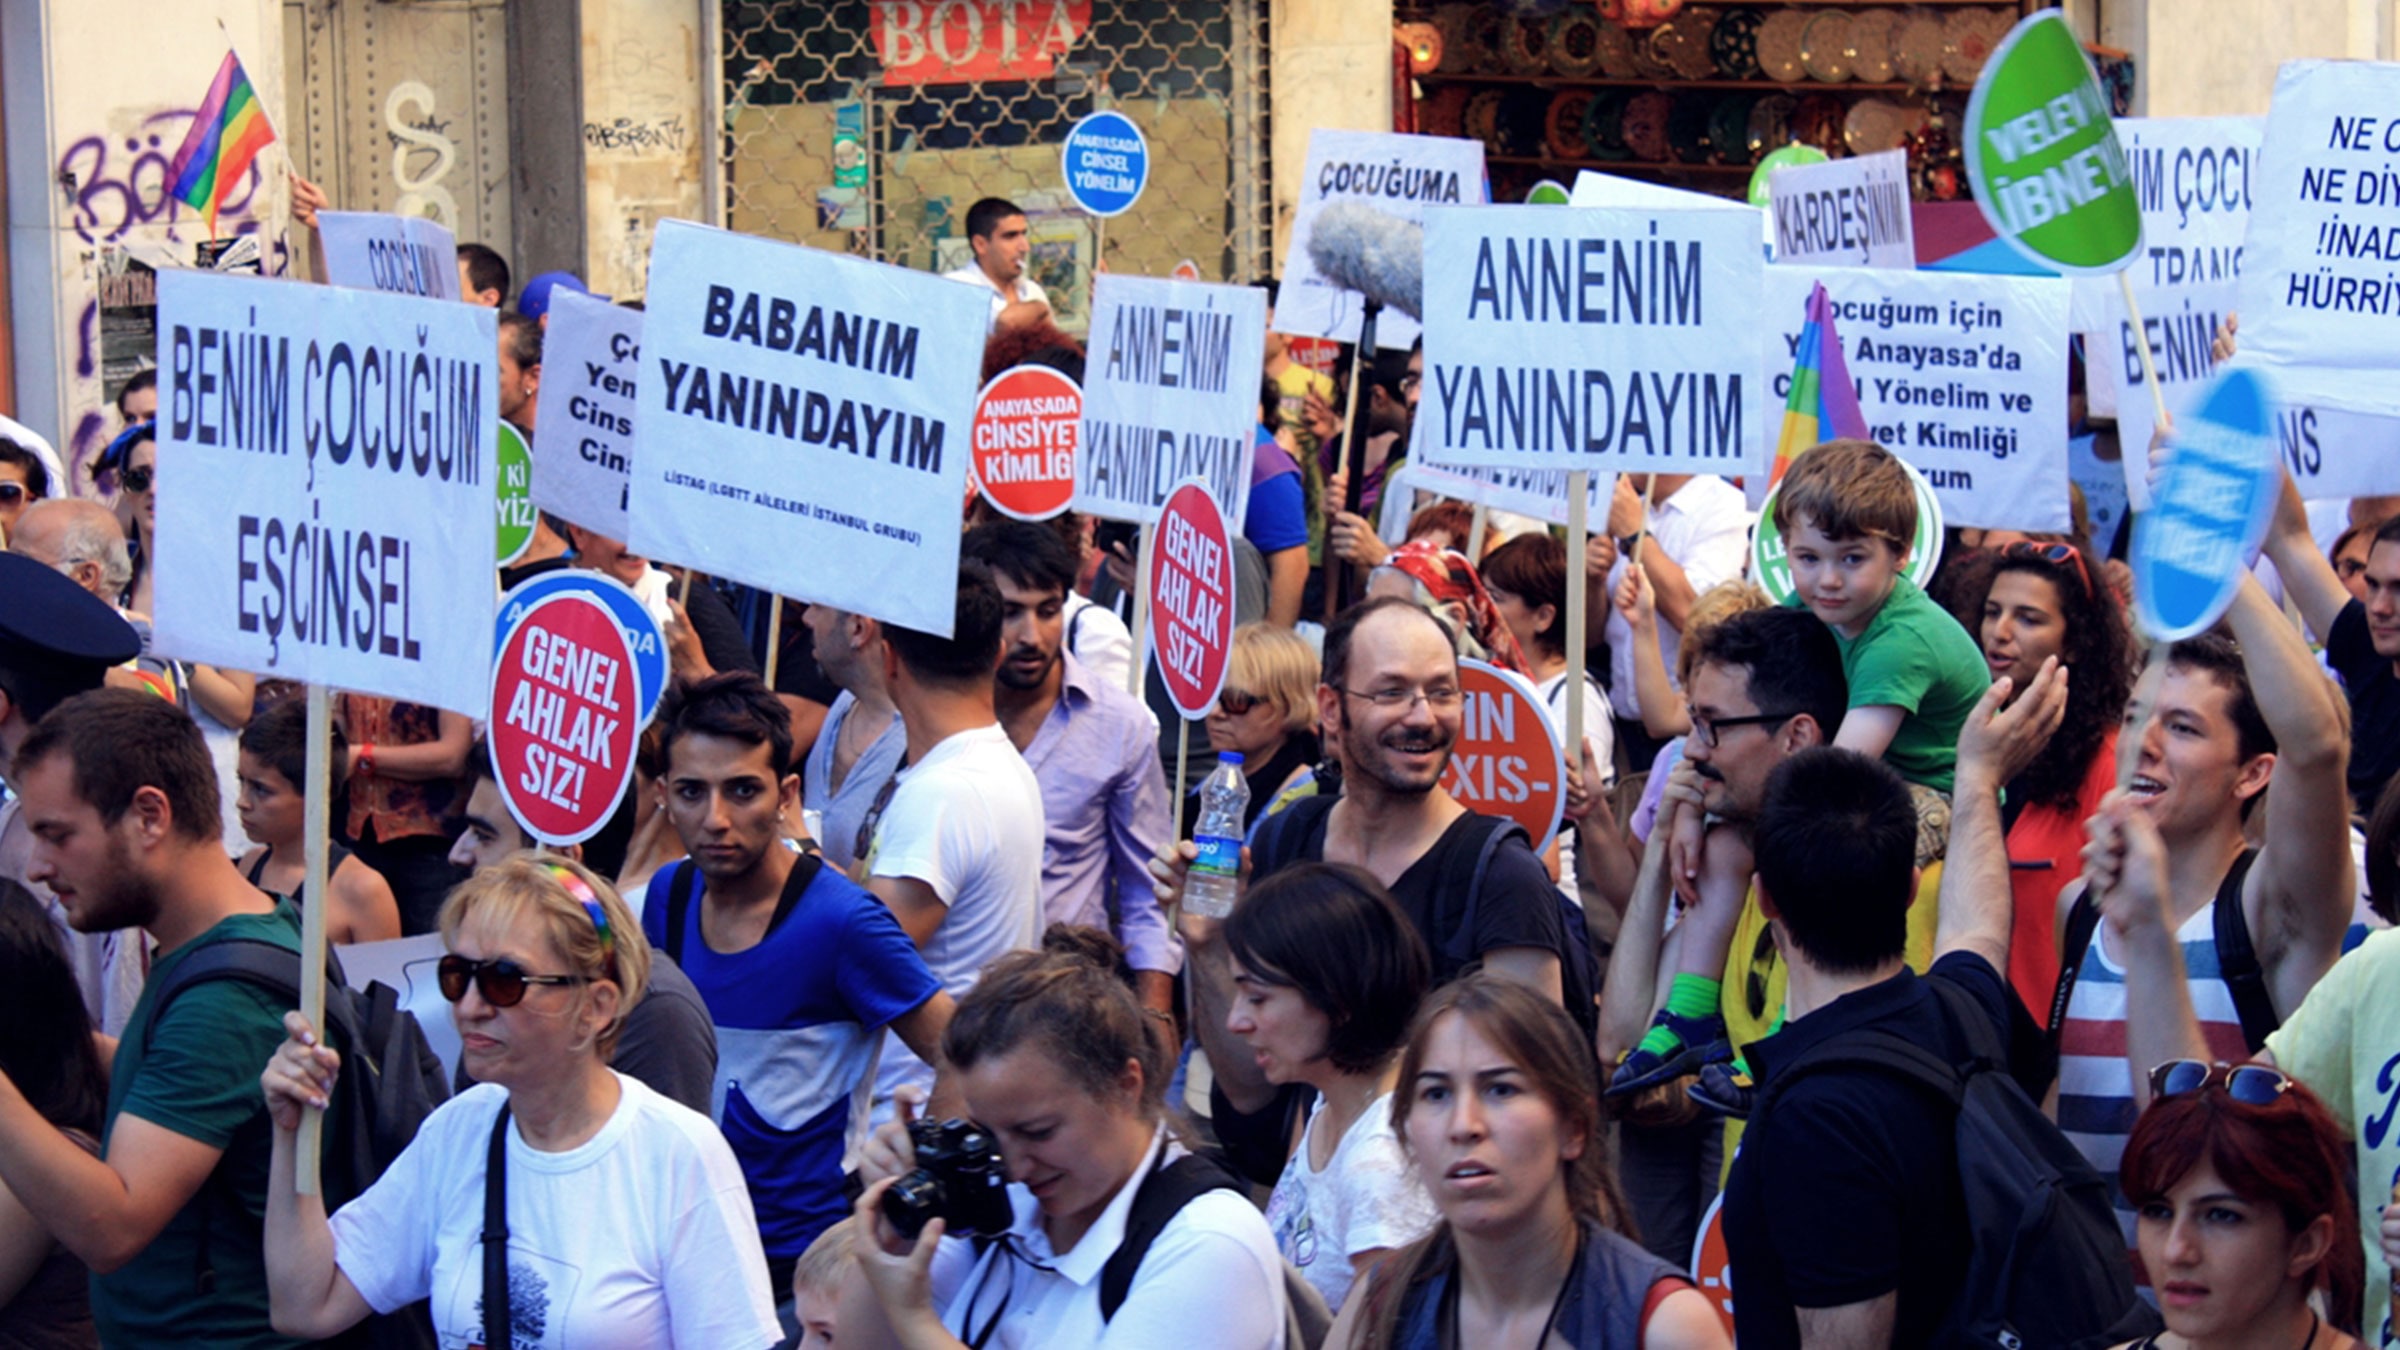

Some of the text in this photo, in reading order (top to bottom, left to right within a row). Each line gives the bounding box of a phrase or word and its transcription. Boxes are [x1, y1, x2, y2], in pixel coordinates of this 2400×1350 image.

[880, 0, 1077, 67] BOTA
[1080, 148, 1131, 173] CİNSEL
[2329, 115, 2377, 151] NE
[1073, 169, 1137, 195] YÖNELİM
[1319, 158, 1461, 204] ÇOCUĞUMA
[2300, 166, 2347, 203] NE
[1467, 219, 1703, 327] ANNENİM
[702, 283, 921, 381] BABANIM
[1105, 293, 1233, 394] ANNENİM
[1949, 300, 2003, 334] için
[1855, 335, 2022, 372] Anayasa'da
[172, 304, 482, 493] BENİM ÇOCUĞUM
[659, 356, 946, 475] YANINDAYIM
[983, 395, 1079, 419] ANAYASADA
[1434, 363, 1743, 459] YANINDAYIM
[1874, 377, 1990, 412] Yönelim
[1999, 391, 2033, 414] ve
[975, 415, 1081, 451] CİNSİYET
[1916, 420, 2018, 460] Kimliği
[664, 469, 706, 491] LİSTAG
[753, 491, 810, 517] AİLELERİ
[812, 503, 870, 533] İSTANBUL
[872, 522, 922, 547] GRUBU)
[238, 497, 422, 668] EŞCİNSEL
[1164, 509, 1224, 597] GENEL
[1157, 559, 1224, 651] AHLAK
[521, 625, 621, 713] GENEL
[1166, 620, 1205, 691] SIZ!
[505, 679, 620, 770] AHLAK
[520, 742, 587, 815] SIZ!
